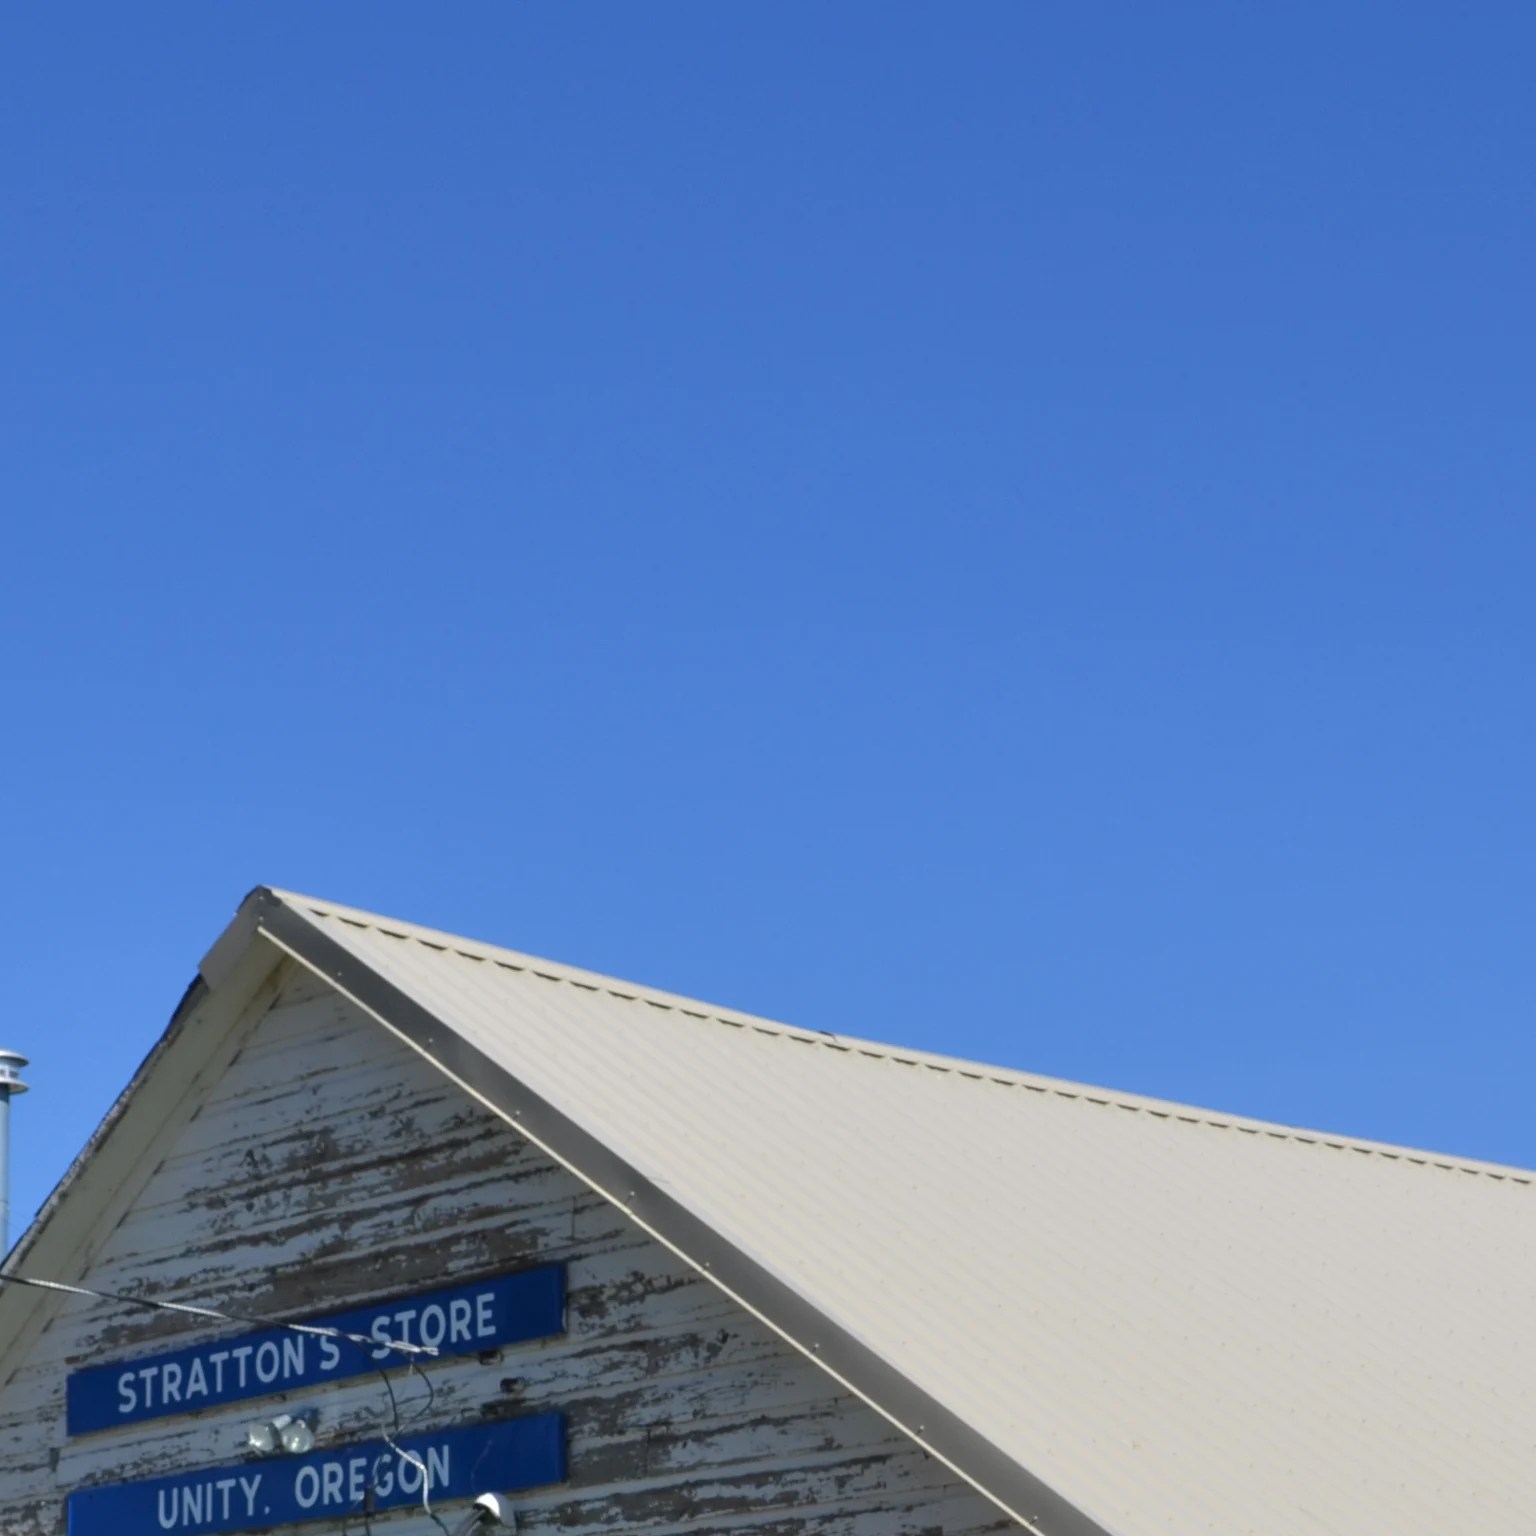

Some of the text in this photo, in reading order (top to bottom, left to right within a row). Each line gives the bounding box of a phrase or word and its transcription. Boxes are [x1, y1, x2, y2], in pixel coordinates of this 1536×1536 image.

[117, 1292, 497, 1413] STRATTON'S STORE
[294, 1444, 451, 1509] OREGON
